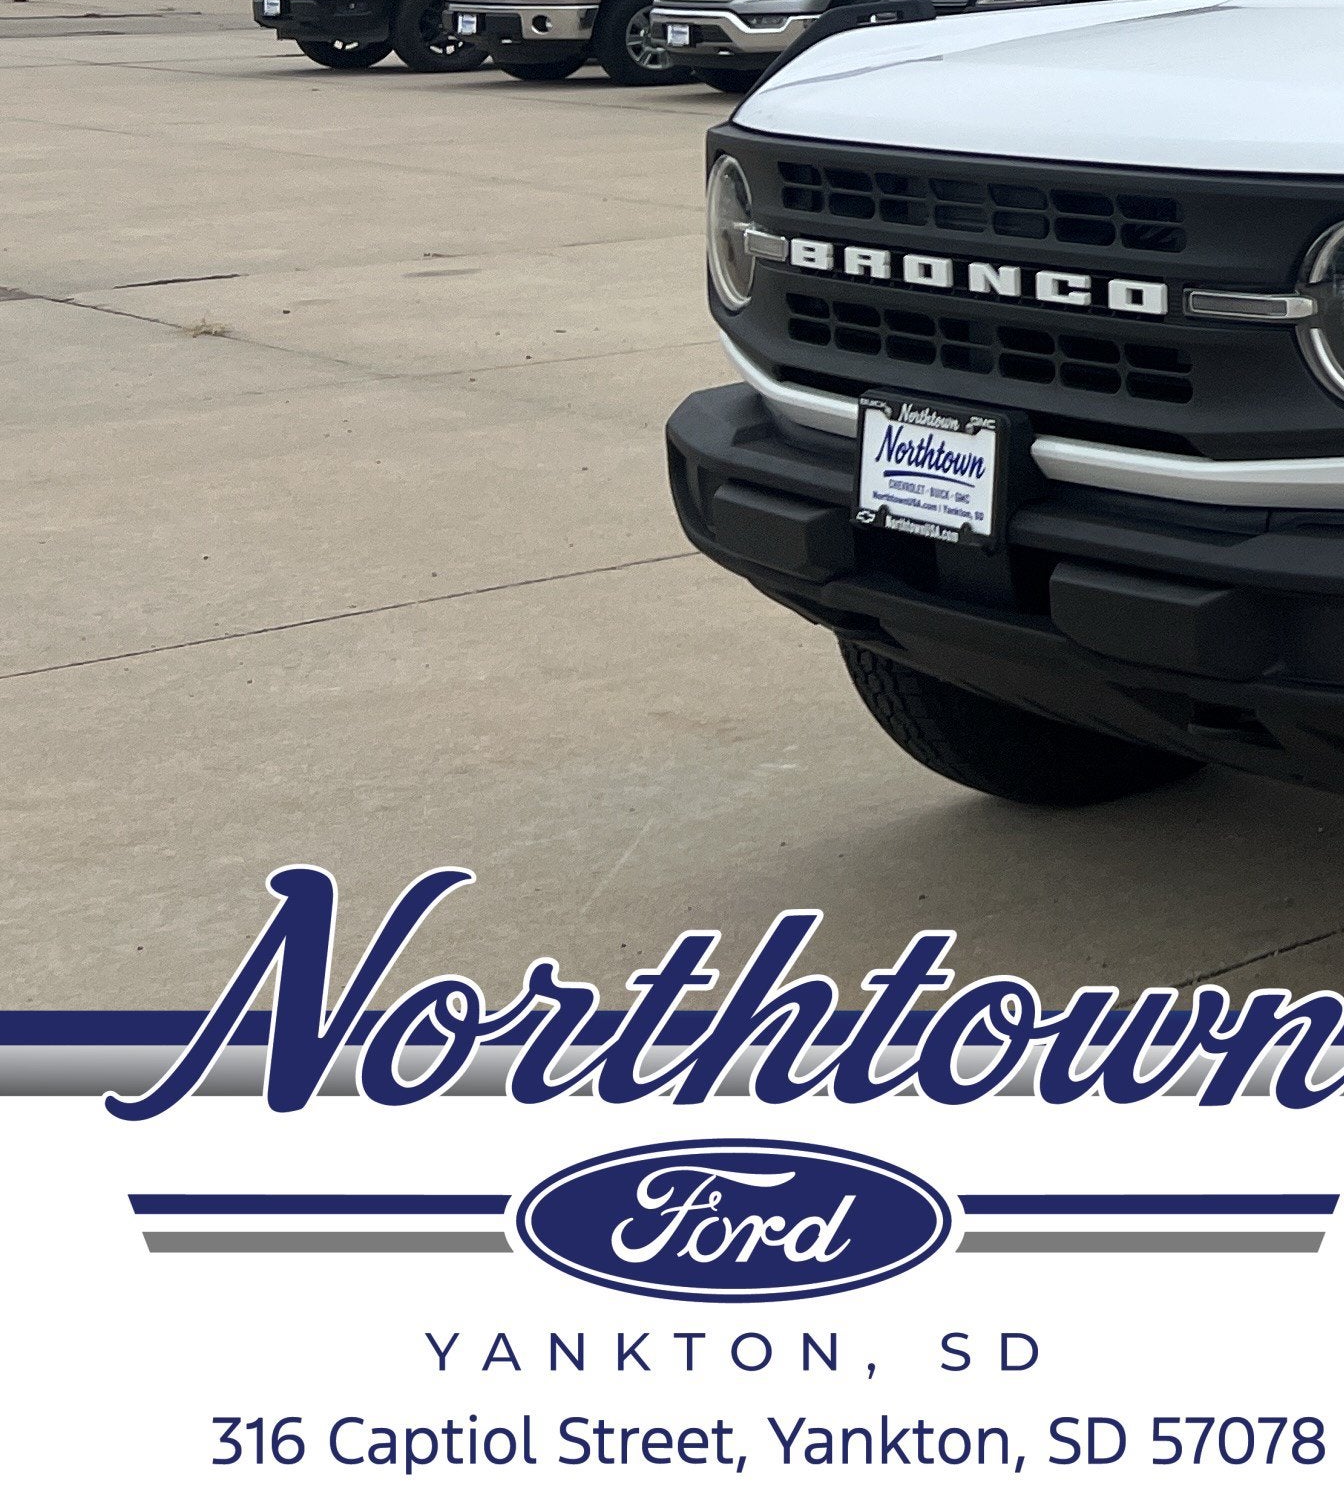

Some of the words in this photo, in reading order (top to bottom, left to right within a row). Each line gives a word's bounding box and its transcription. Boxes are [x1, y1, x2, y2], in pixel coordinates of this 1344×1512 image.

[791, 237, 1168, 315] BRONCO
[898, 403, 960, 432] Northtown
[875, 424, 986, 479] Northtown
